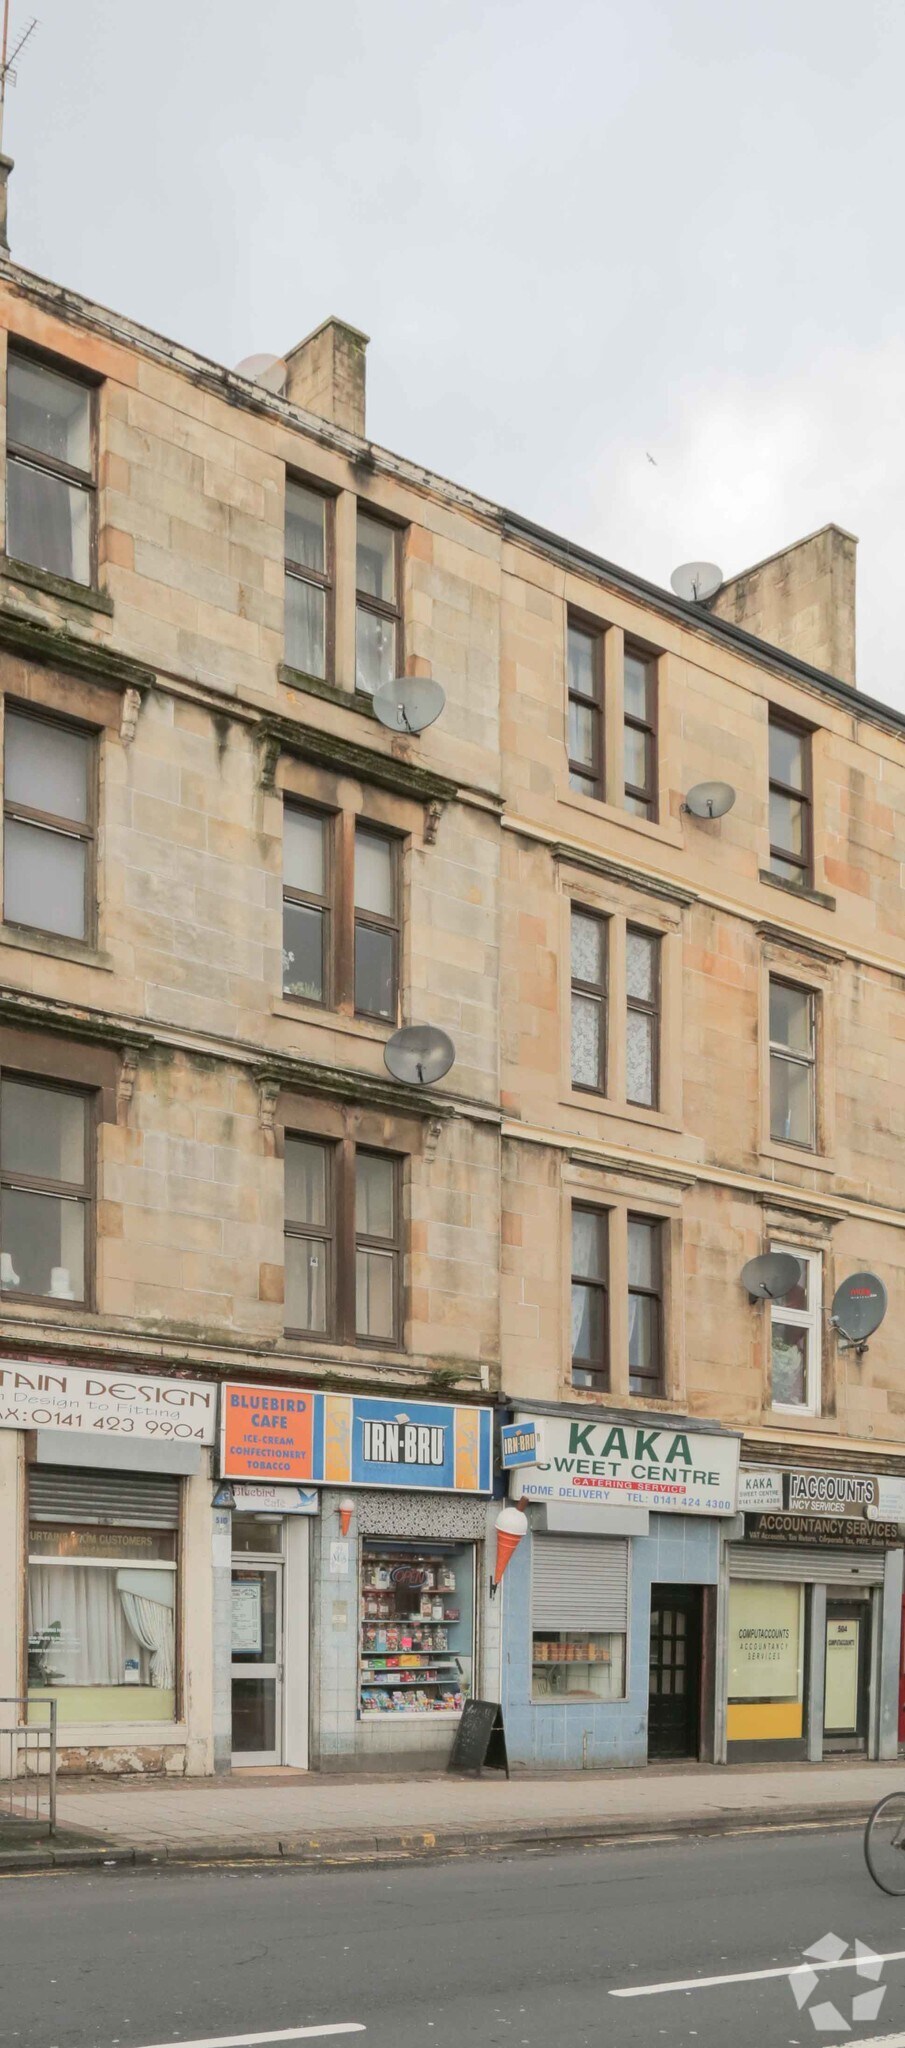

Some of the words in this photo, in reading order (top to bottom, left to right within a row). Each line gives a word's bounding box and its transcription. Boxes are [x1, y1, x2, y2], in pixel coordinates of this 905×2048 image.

[85, 1379, 210, 1408] DESIGN
[14, 1392, 80, 1409] Design
[89, 1401, 109, 1411] to
[117, 1403, 180, 1420] Fitting
[230, 1394, 307, 1413] BLUEBIRD
[93, 1416, 134, 1432] 423
[145, 1420, 205, 1439] 9904
[251, 1414, 288, 1429] CAFE
[364, 1422, 444, 1465] IRN-BRU
[504, 1433, 535, 1455] IRN-BRU
[568, 1422, 694, 1466] KAKA
[230, 1446, 306, 1460] CONFECTIONERY
[247, 1460, 291, 1471] TOBACCO
[631, 1464, 720, 1486] CENTRE
[573, 1477, 633, 1489] CATERING
[637, 1483, 686, 1494] SERVICE
[745, 1478, 773, 1489] KAKA
[522, 1484, 554, 1496] HOME
[559, 1487, 610, 1500] DELIVERY
[627, 1492, 648, 1504] TEL:
[653, 1494, 677, 1506] 0141
[681, 1496, 701, 1507] 424
[705, 1498, 731, 1510] 4300
[759, 1489, 779, 1497] CENTRE
[810, 1501, 845, 1513] SERVICES
[759, 1515, 844, 1534] ACCOUNTANCY
[846, 1521, 897, 1537] SERVICES
[99, 1533, 153, 1546] CUSTOMERS
[749, 1531, 760, 1539] VAT
[395, 1570, 424, 1584] OPEN
[739, 1628, 790, 1639] COMPUTACCOUNTS
[740, 1642, 788, 1650] ACCOUNTANCY
[748, 1652, 781, 1660] SERVICES
